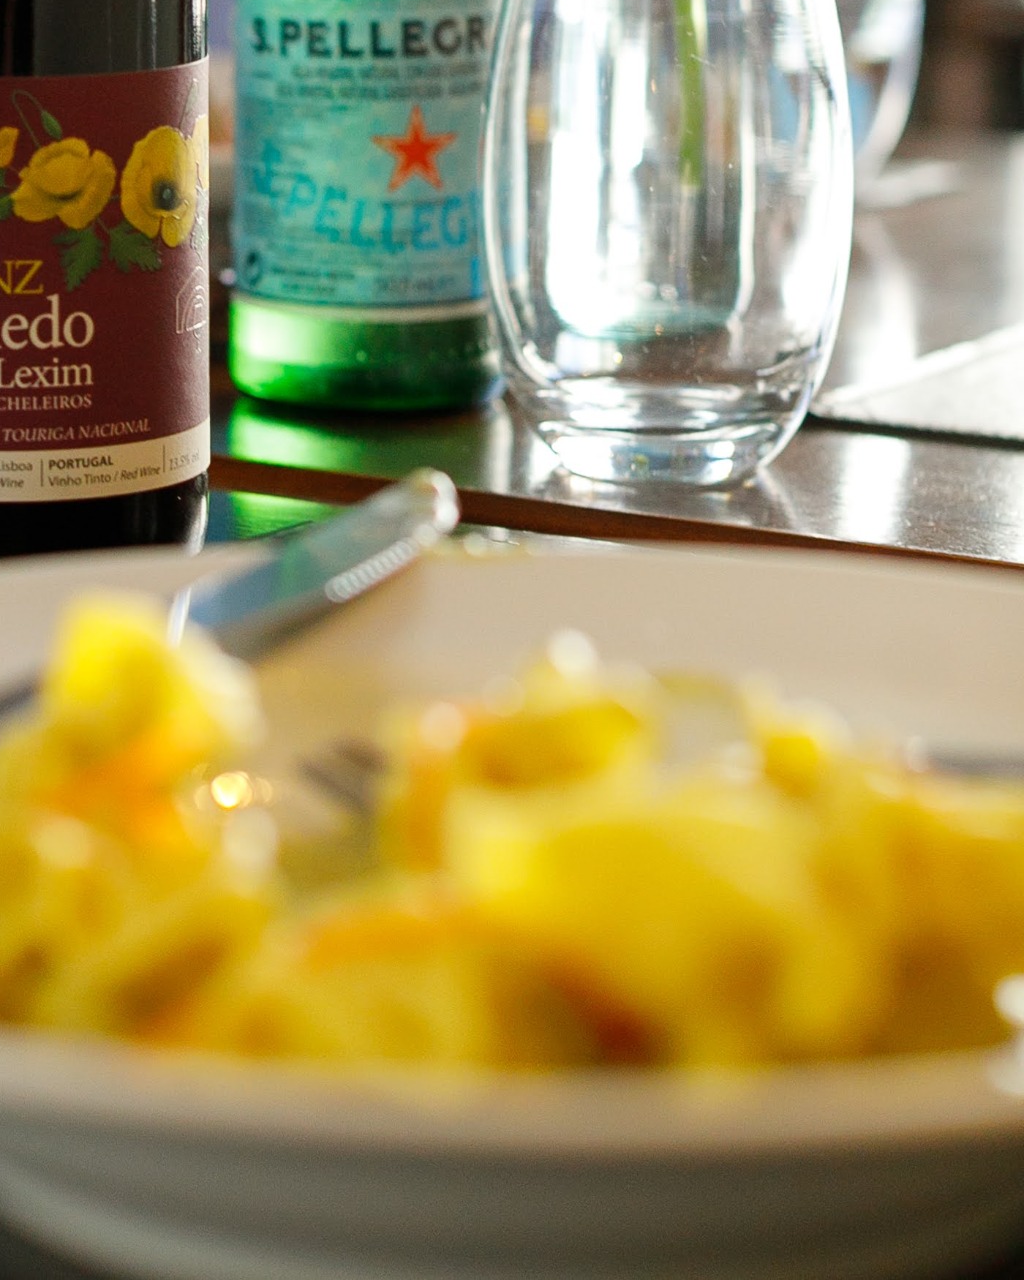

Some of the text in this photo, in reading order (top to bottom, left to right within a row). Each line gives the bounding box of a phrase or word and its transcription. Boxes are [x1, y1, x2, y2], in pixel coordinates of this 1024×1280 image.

[2, 426, 74, 442] TOURIGA
[78, 418, 151, 438] NACIONAL
[48, 455, 114, 470] PORTUGAL
[48, 475, 82, 487] Vinho
[84, 472, 112, 484] Tinto
[120, 468, 138, 481] Red
[139, 465, 161, 478] Wine
